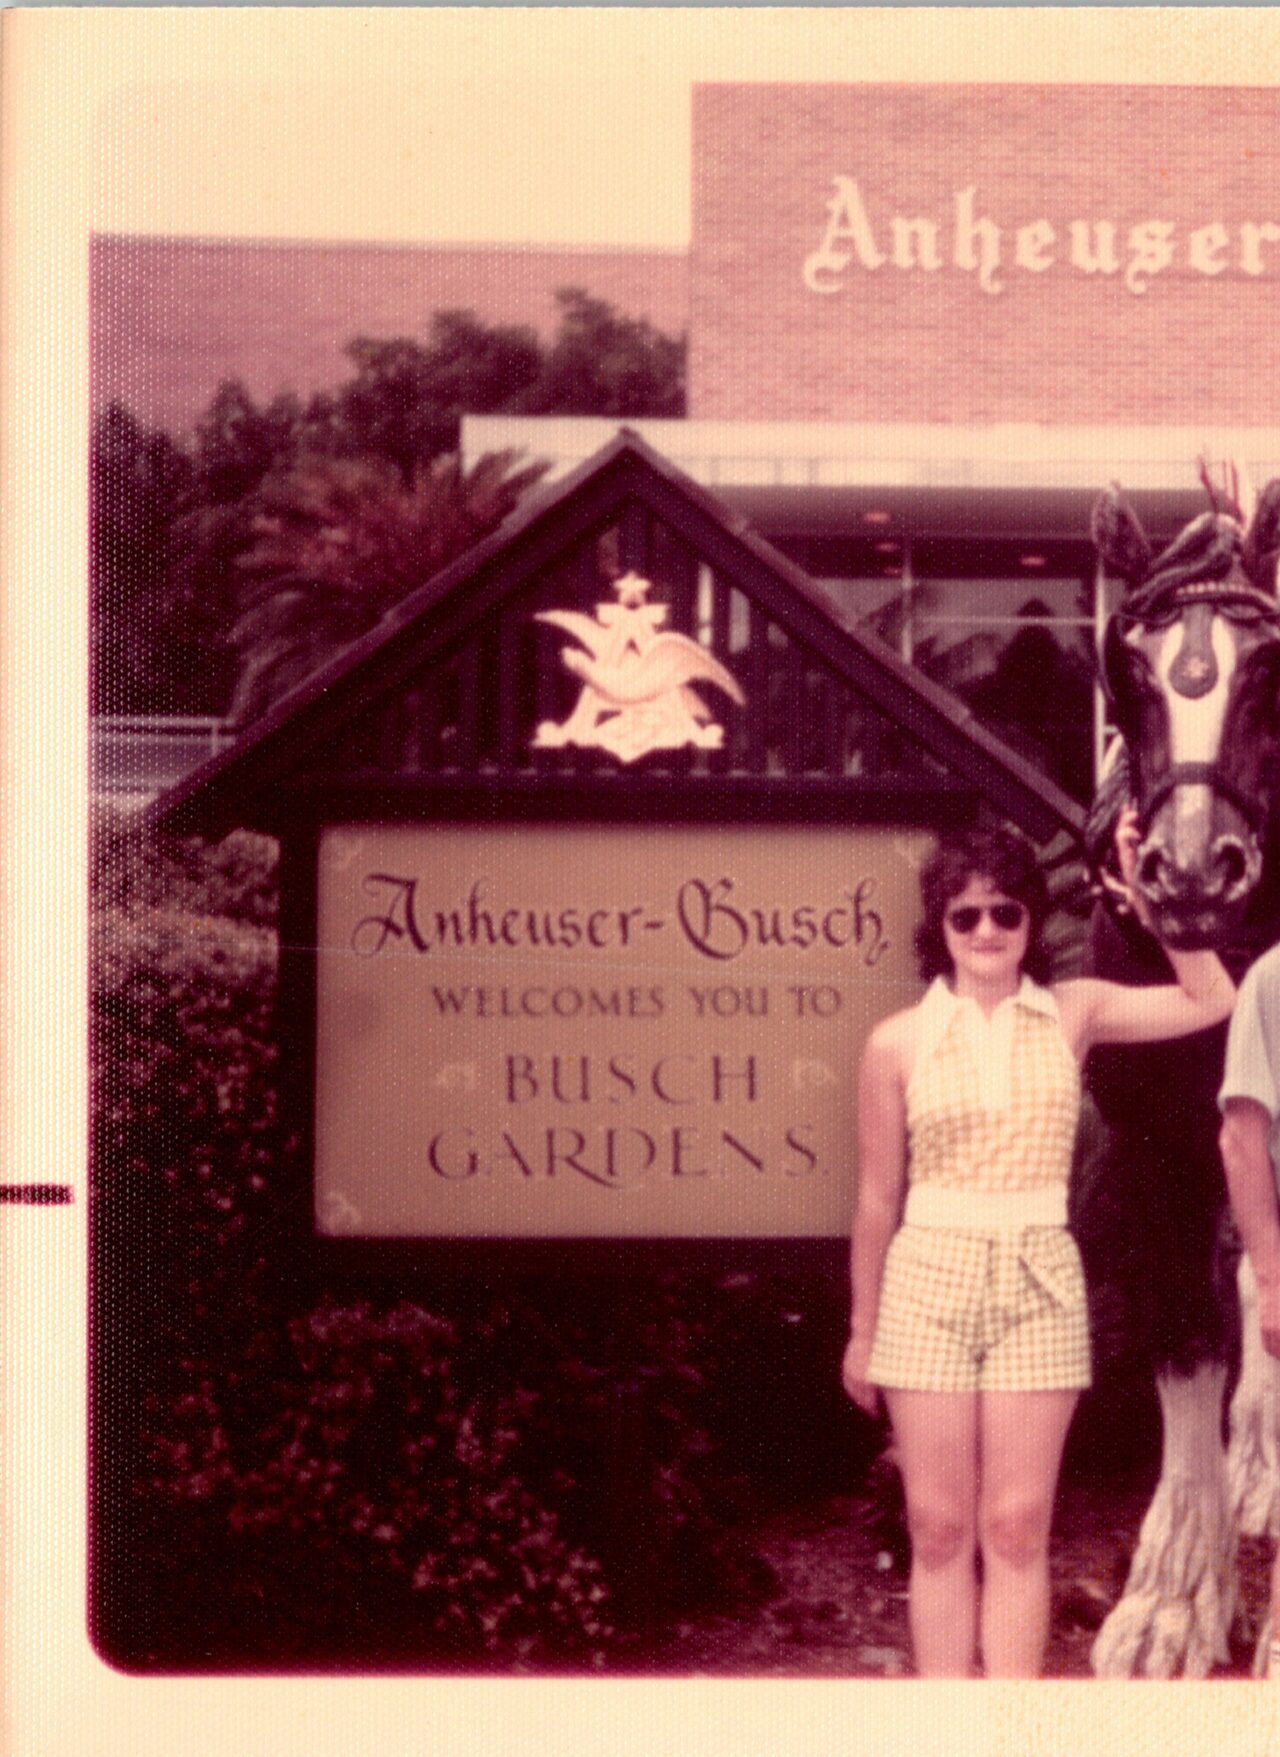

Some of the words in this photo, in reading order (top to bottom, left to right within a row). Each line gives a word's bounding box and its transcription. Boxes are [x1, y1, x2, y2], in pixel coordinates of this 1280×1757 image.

[431, 986, 665, 1018] WELCOMES
[688, 986, 769, 1018] YOU
[788, 986, 843, 1018] TO
[505, 1054, 759, 1104] BUSCH
